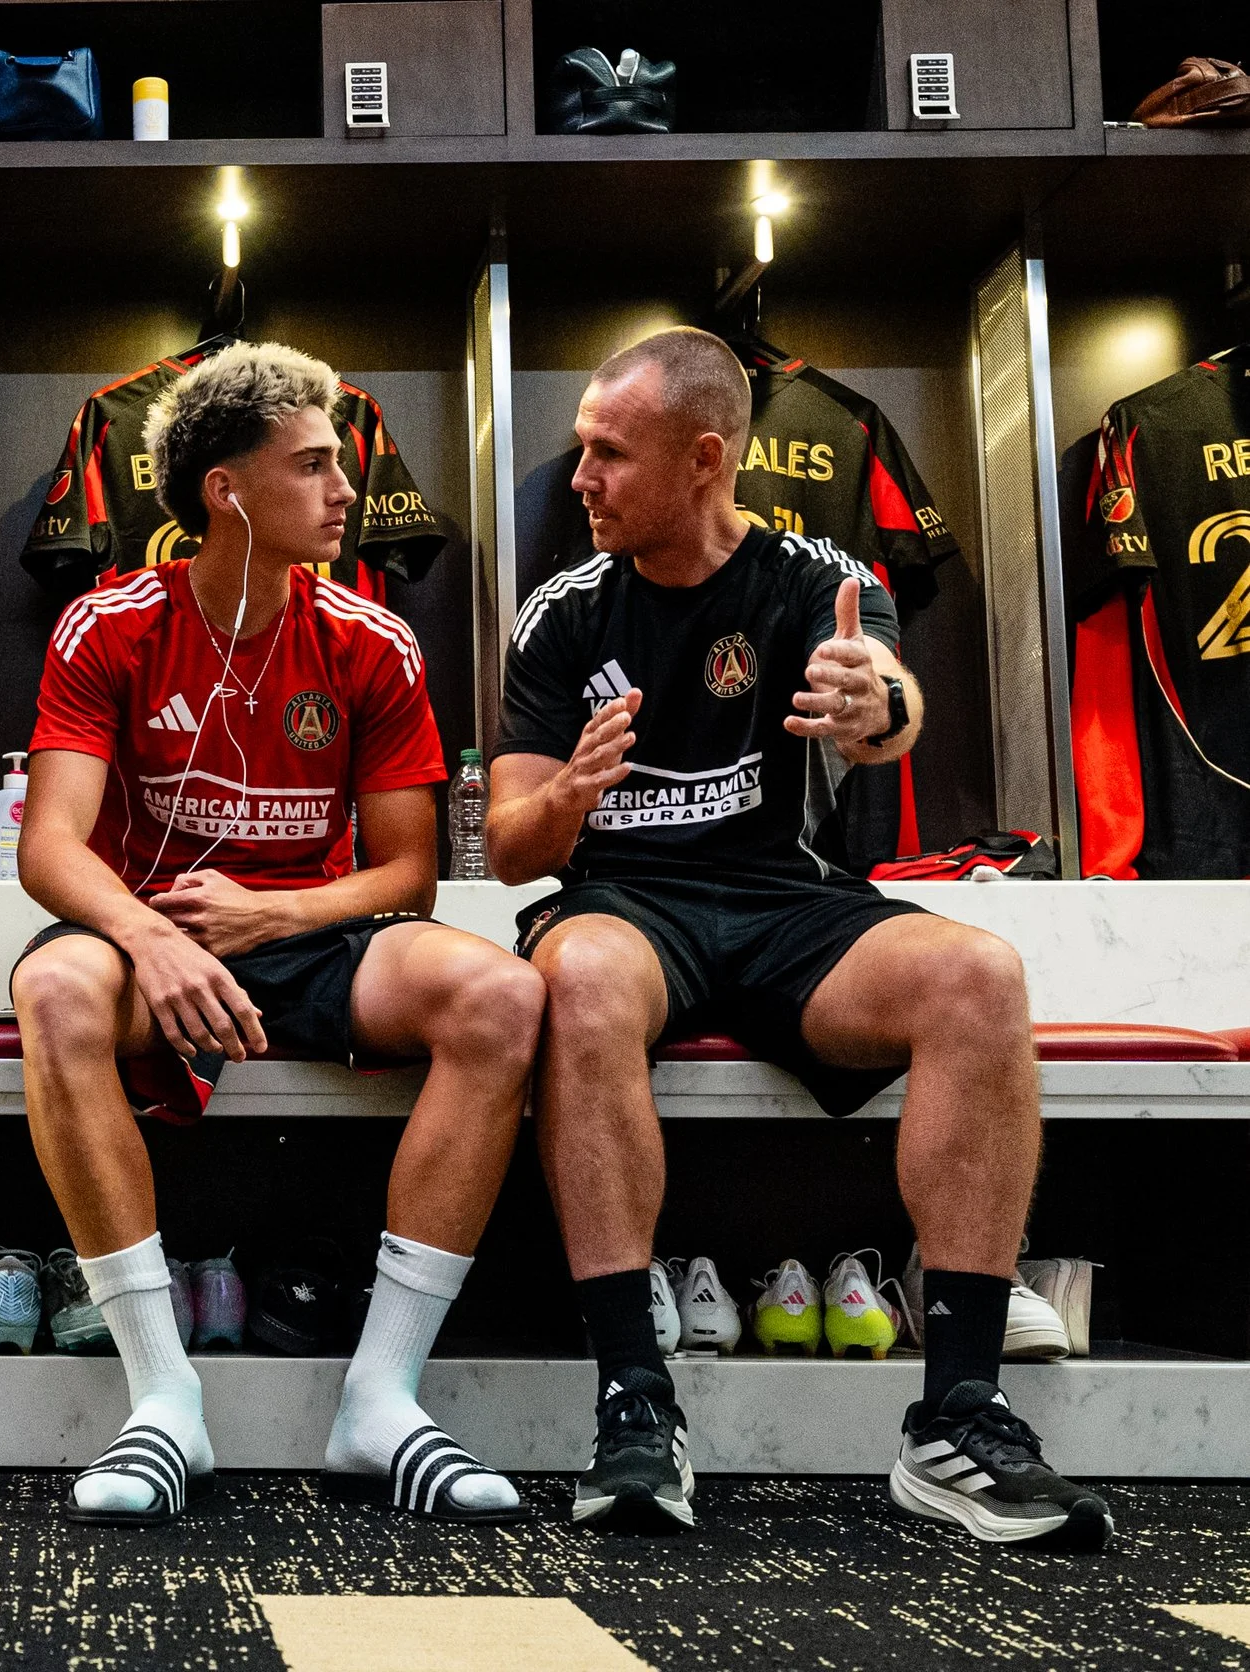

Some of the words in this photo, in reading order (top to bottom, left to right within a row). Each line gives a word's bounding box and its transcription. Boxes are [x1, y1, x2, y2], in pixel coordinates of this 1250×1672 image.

[737, 436, 834, 481] ALES
[365, 491, 431, 515] MOR
[1121, 532, 1148, 552] tv
[711, 681, 741, 695] UNITED
[742, 674, 754, 686] FC
[291, 693, 331, 708] ATLANTA
[289, 731, 320, 749] UNITED
[321, 733, 333, 744] FC
[694, 766, 761, 802] FAMILY
[143, 788, 250, 818] AMERICAN
[258, 801, 331, 819] FAMILY
[595, 795, 752, 825] INSURANCE
[156, 809, 316, 836] INSURANCE
